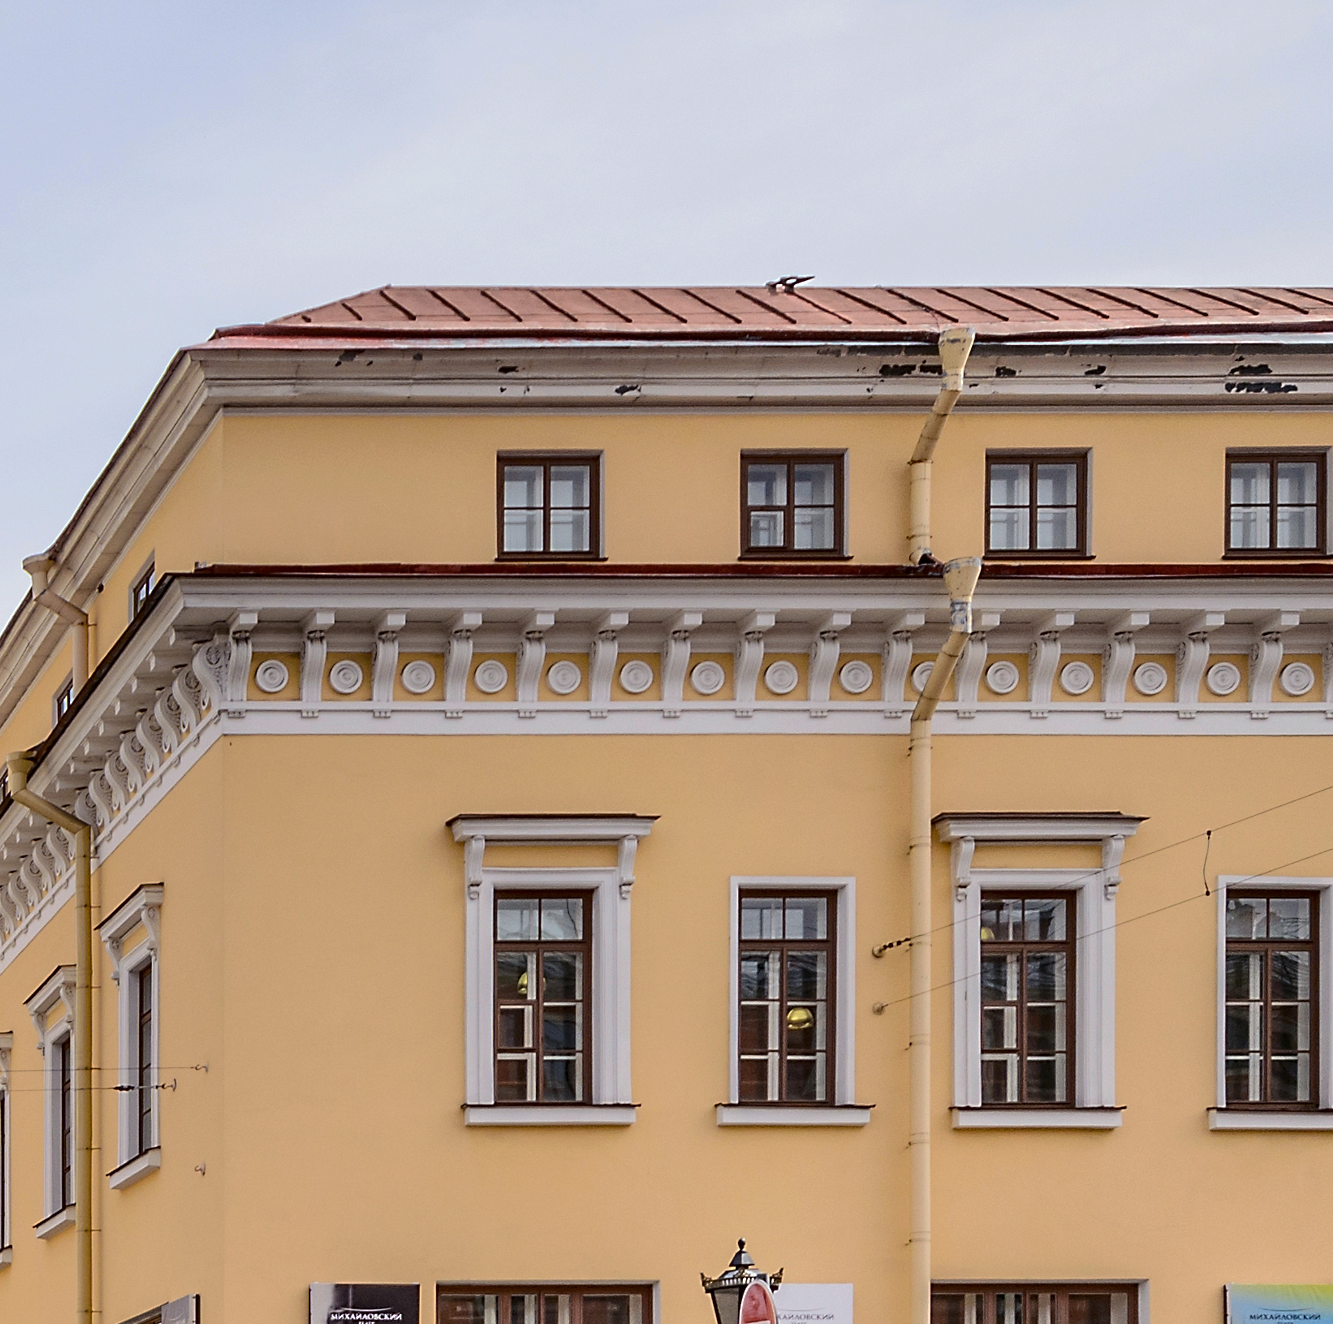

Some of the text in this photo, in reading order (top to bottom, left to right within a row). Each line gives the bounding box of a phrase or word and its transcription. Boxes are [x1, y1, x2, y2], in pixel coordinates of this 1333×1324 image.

[330, 1312, 402, 1320] МИХАЙЛОВСКИЙ
[776, 1312, 835, 1320] ХАЙЛОВСКИЙ
[1250, 1312, 1321, 1320] МИХАЙЛОВСКИЙ
